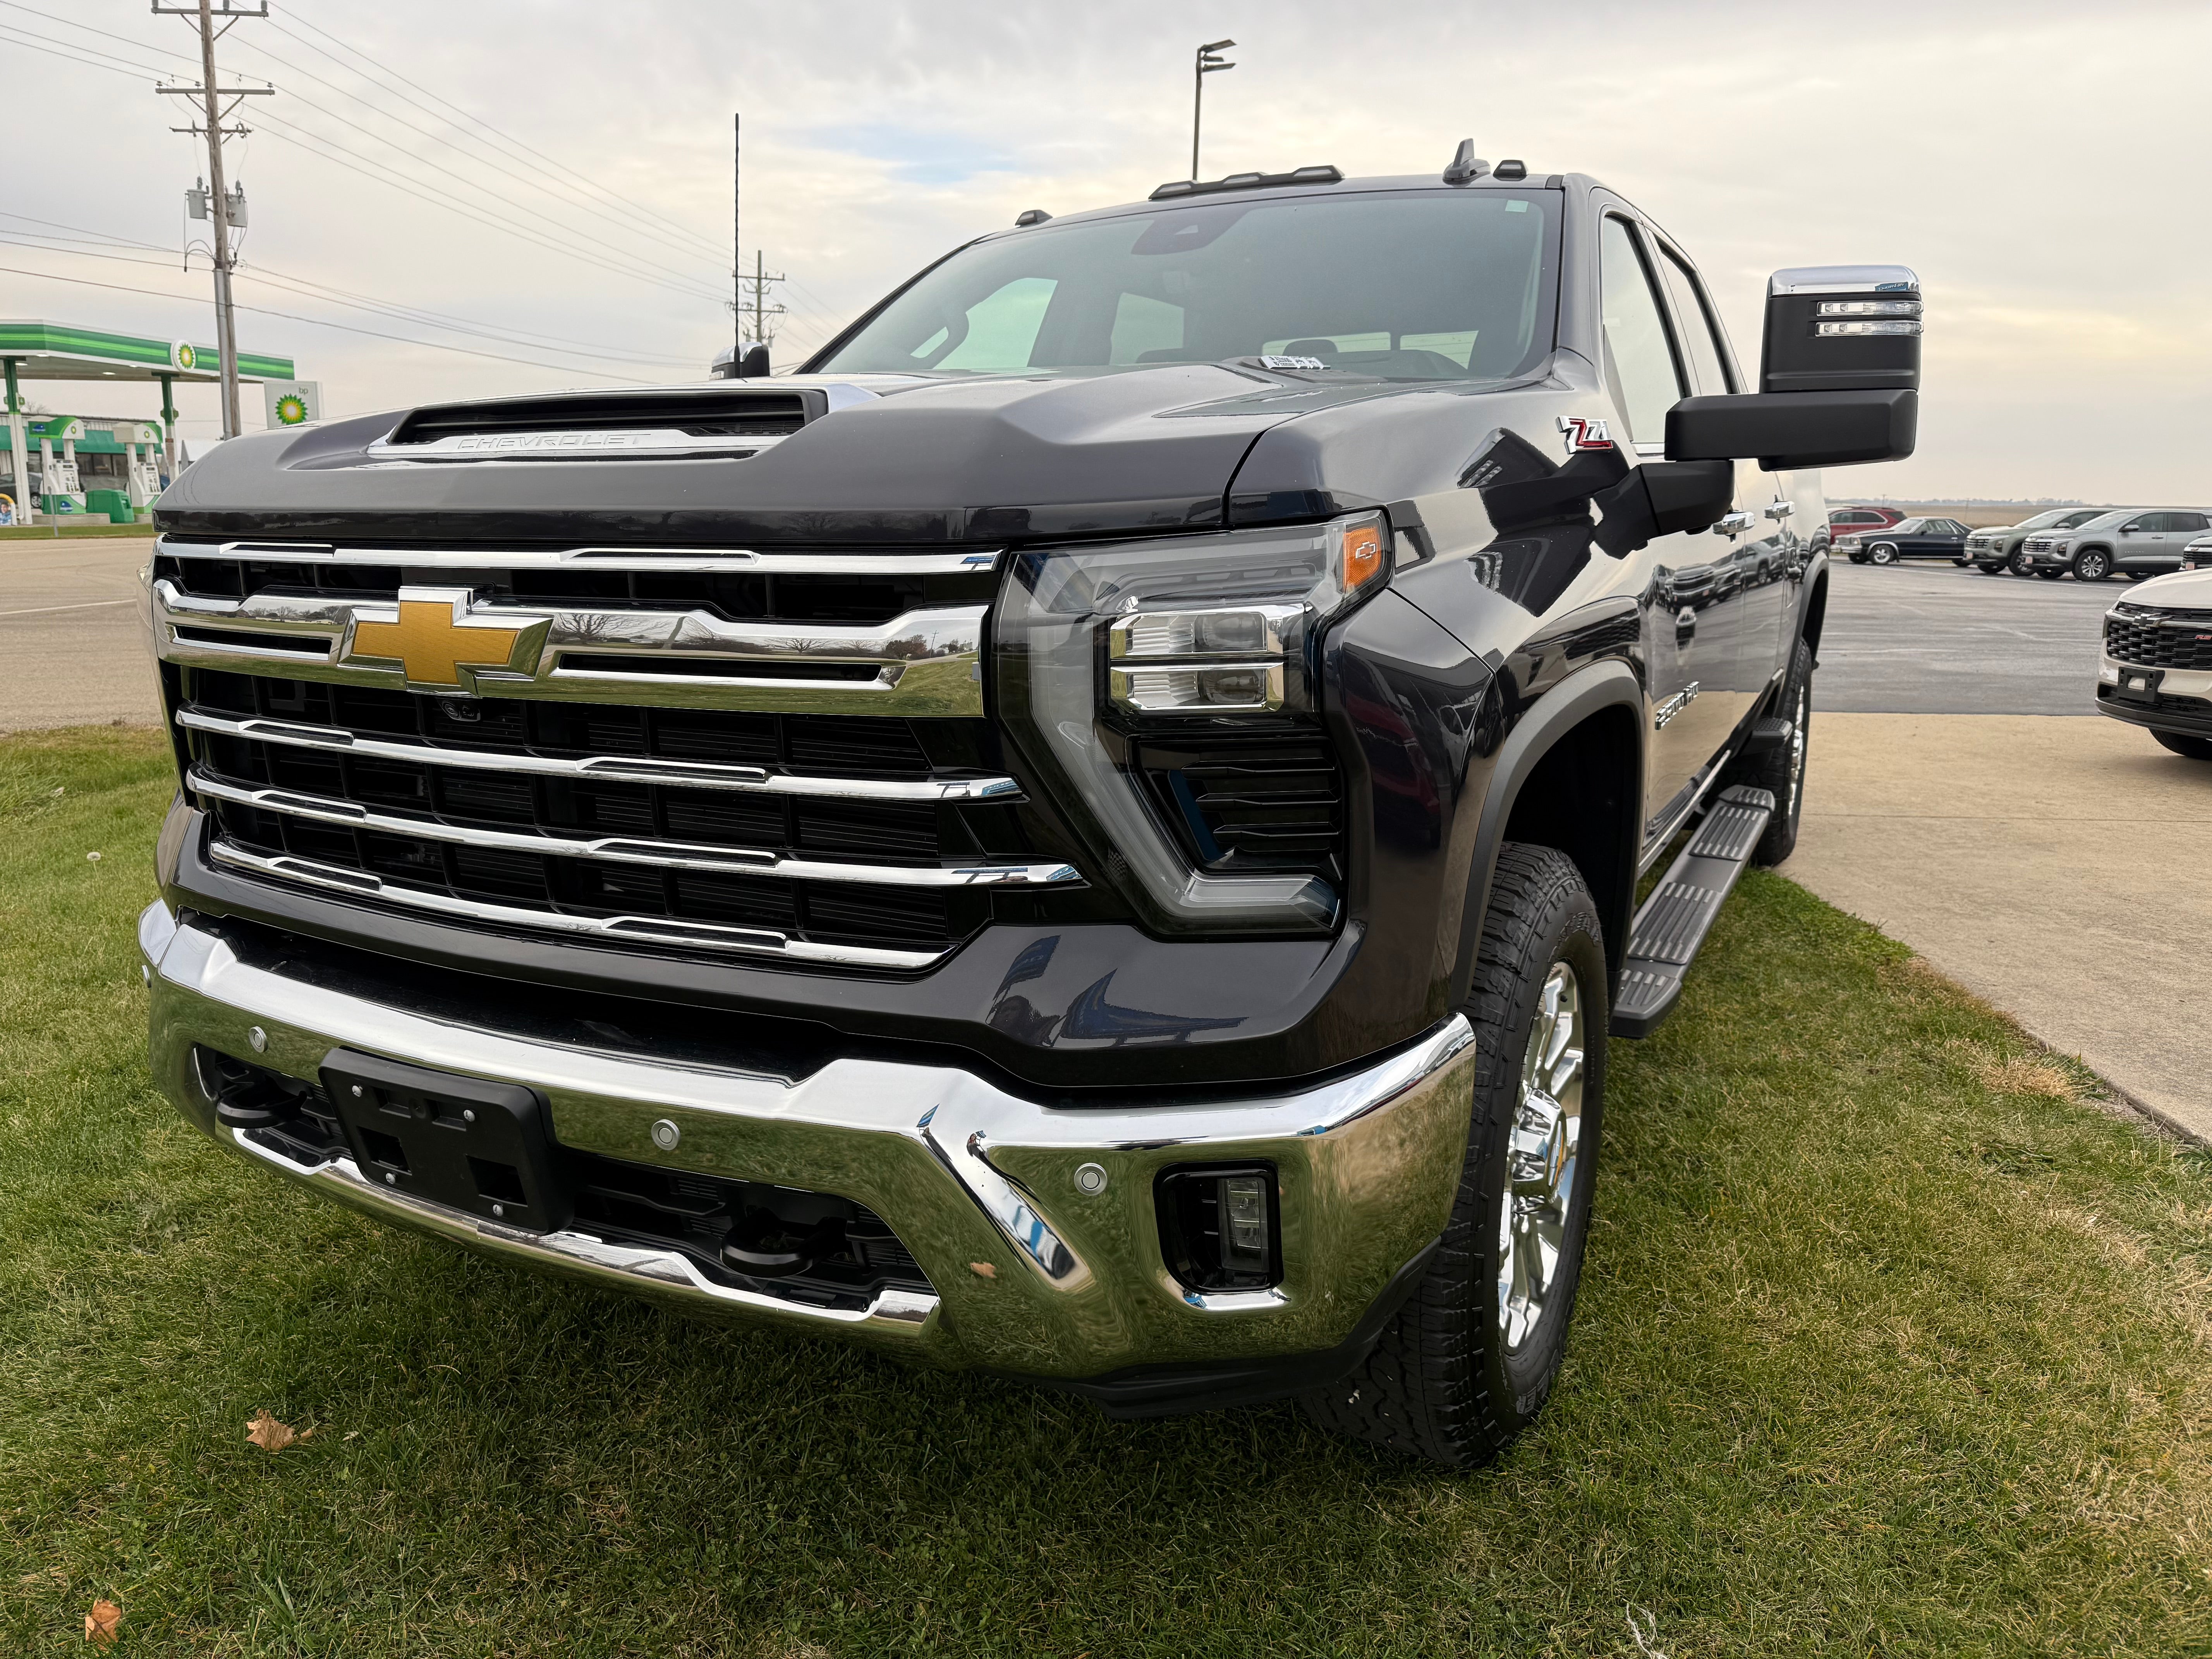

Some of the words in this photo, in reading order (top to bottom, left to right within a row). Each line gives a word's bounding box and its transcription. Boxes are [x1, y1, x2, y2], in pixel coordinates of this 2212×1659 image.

[299, 387, 308, 395] bp
[458, 434, 651, 449] CHEVROLET
[1555, 415, 1614, 455] Z71
